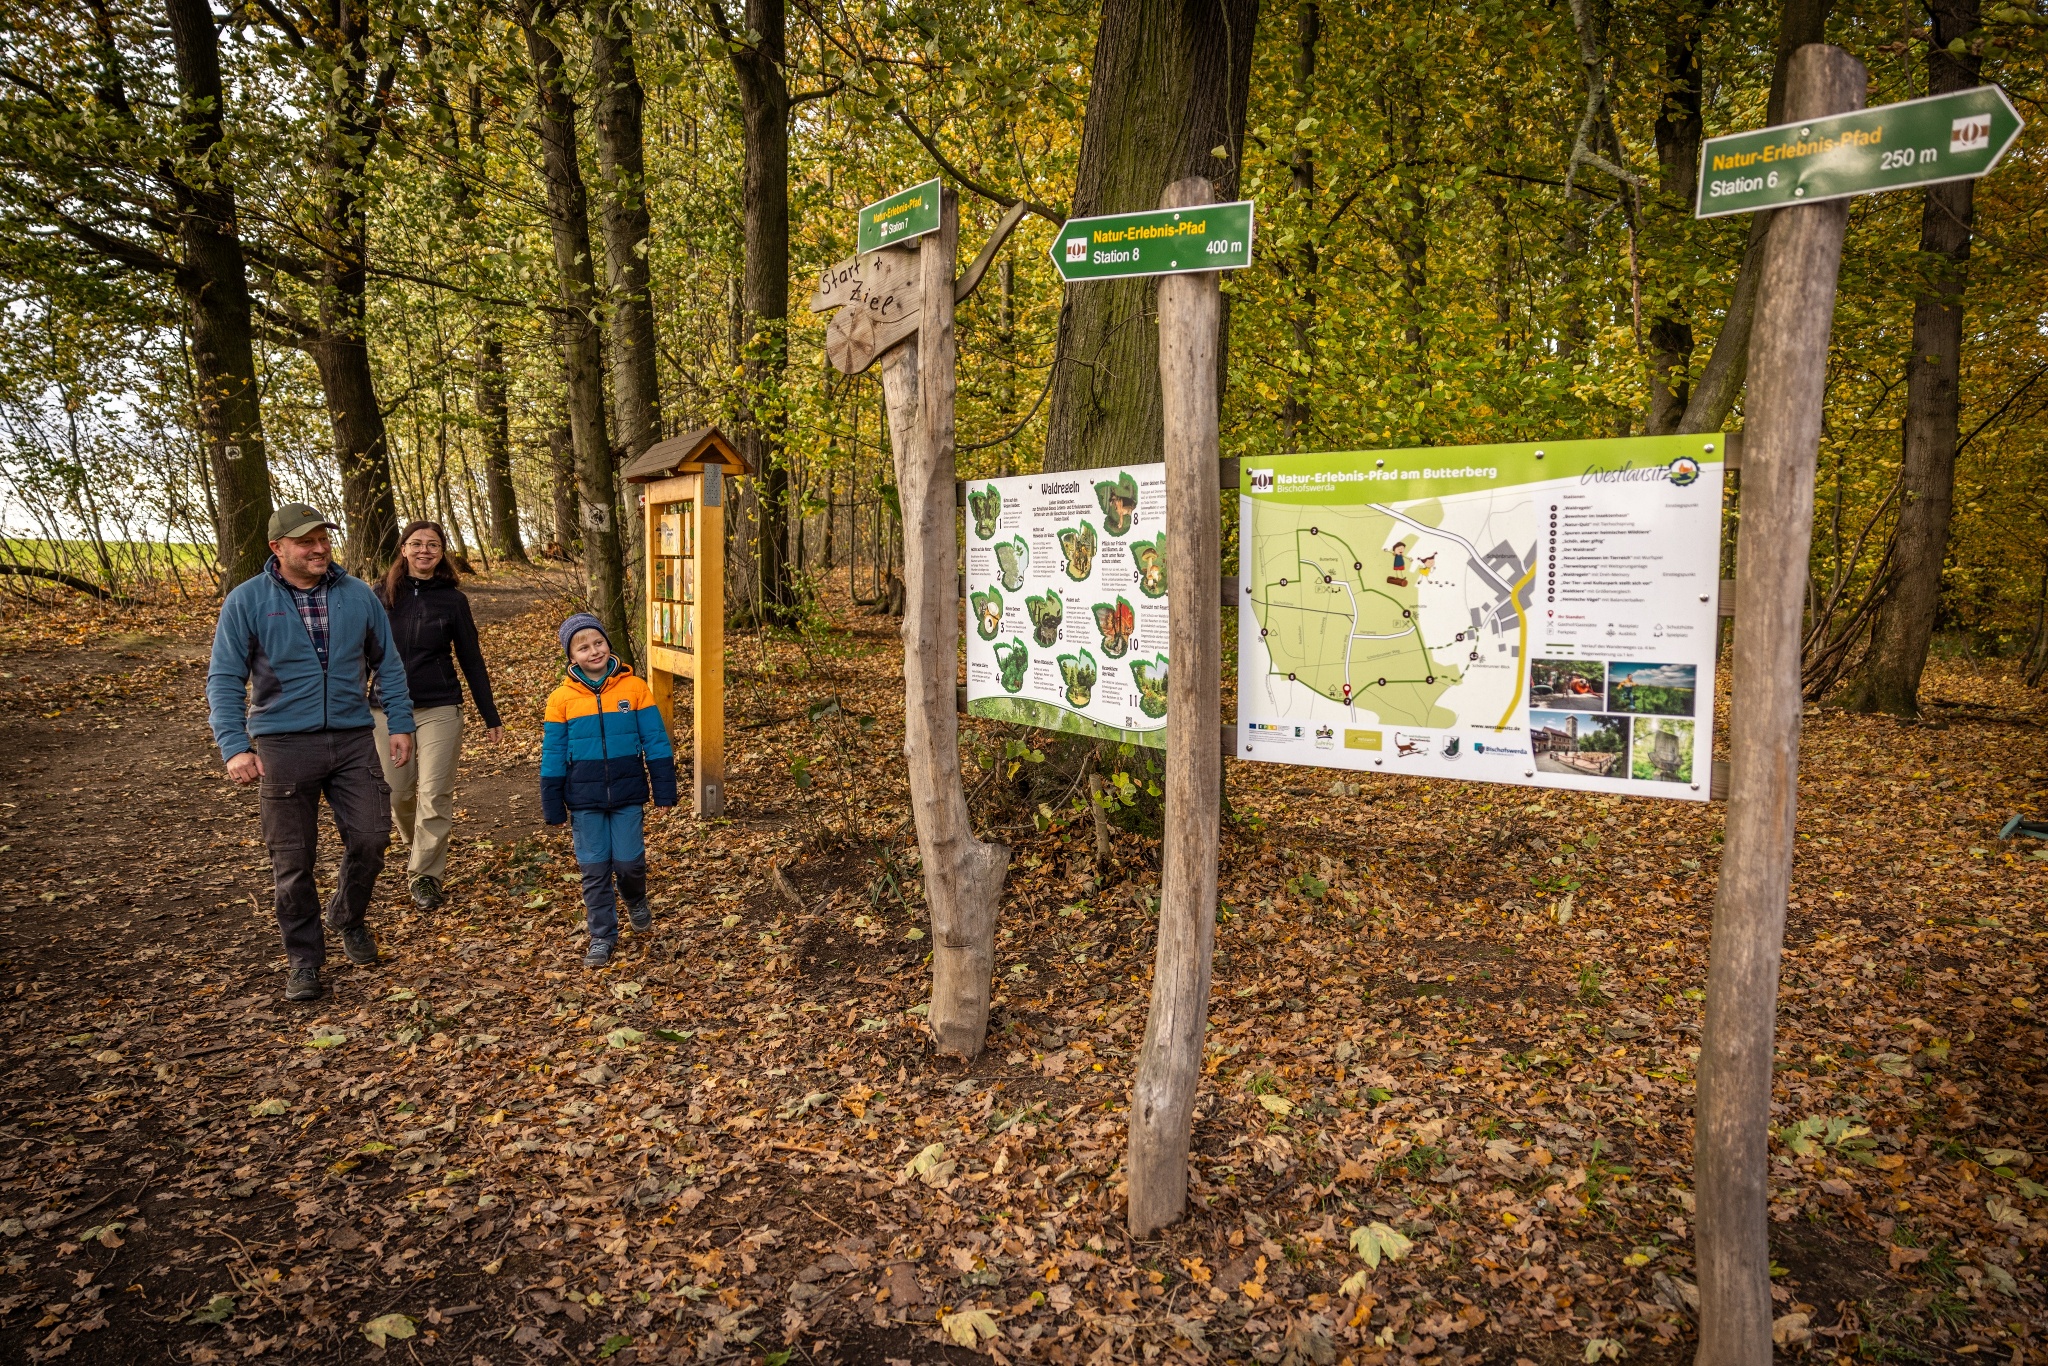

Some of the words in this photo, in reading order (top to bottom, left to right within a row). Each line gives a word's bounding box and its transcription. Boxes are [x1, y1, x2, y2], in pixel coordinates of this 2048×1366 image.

[1712, 126, 1883, 171] Natur-Erlebnis-Pfad
[1880, 149, 1916, 171] 250
[1919, 148, 1938, 163] m
[1709, 174, 1763, 198] Station
[1767, 171, 1779, 188] 6
[873, 196, 922, 223] Natur-Erlebnis-Pfad
[888, 221, 904, 234] Station
[905, 218, 909, 230] 7
[1093, 220, 1206, 243] Natur-Erlebnis-Pfad
[1205, 239, 1228, 254] 400
[1230, 241, 1242, 253] m
[1093, 249, 1129, 264] Station
[1132, 247, 1140, 261] 8
[822, 256, 861, 295] Start
[1277, 469, 1398, 484] Natur-Erlebnis-Pfad
[1400, 470, 1420, 479] am
[1423, 466, 1498, 479] Butterberg
[1580, 460, 1674, 485] Westlausitz
[1041, 481, 1080, 495] Waldregeln
[1277, 484, 1335, 492] Bischofswerda
[1133, 512, 1139, 525] 8
[1060, 560, 1065, 571] 5
[997, 570, 1001, 581] 2
[1133, 571, 1139, 583] 9
[1000, 622, 1005, 633] 3
[1058, 628, 1063, 640] 6
[1129, 638, 1139, 651] 10
[995, 673, 1000, 683] 4
[1058, 686, 1063, 697] 7
[1129, 694, 1138, 707] 11
[1485, 746, 1528, 755] Bischofswerda
